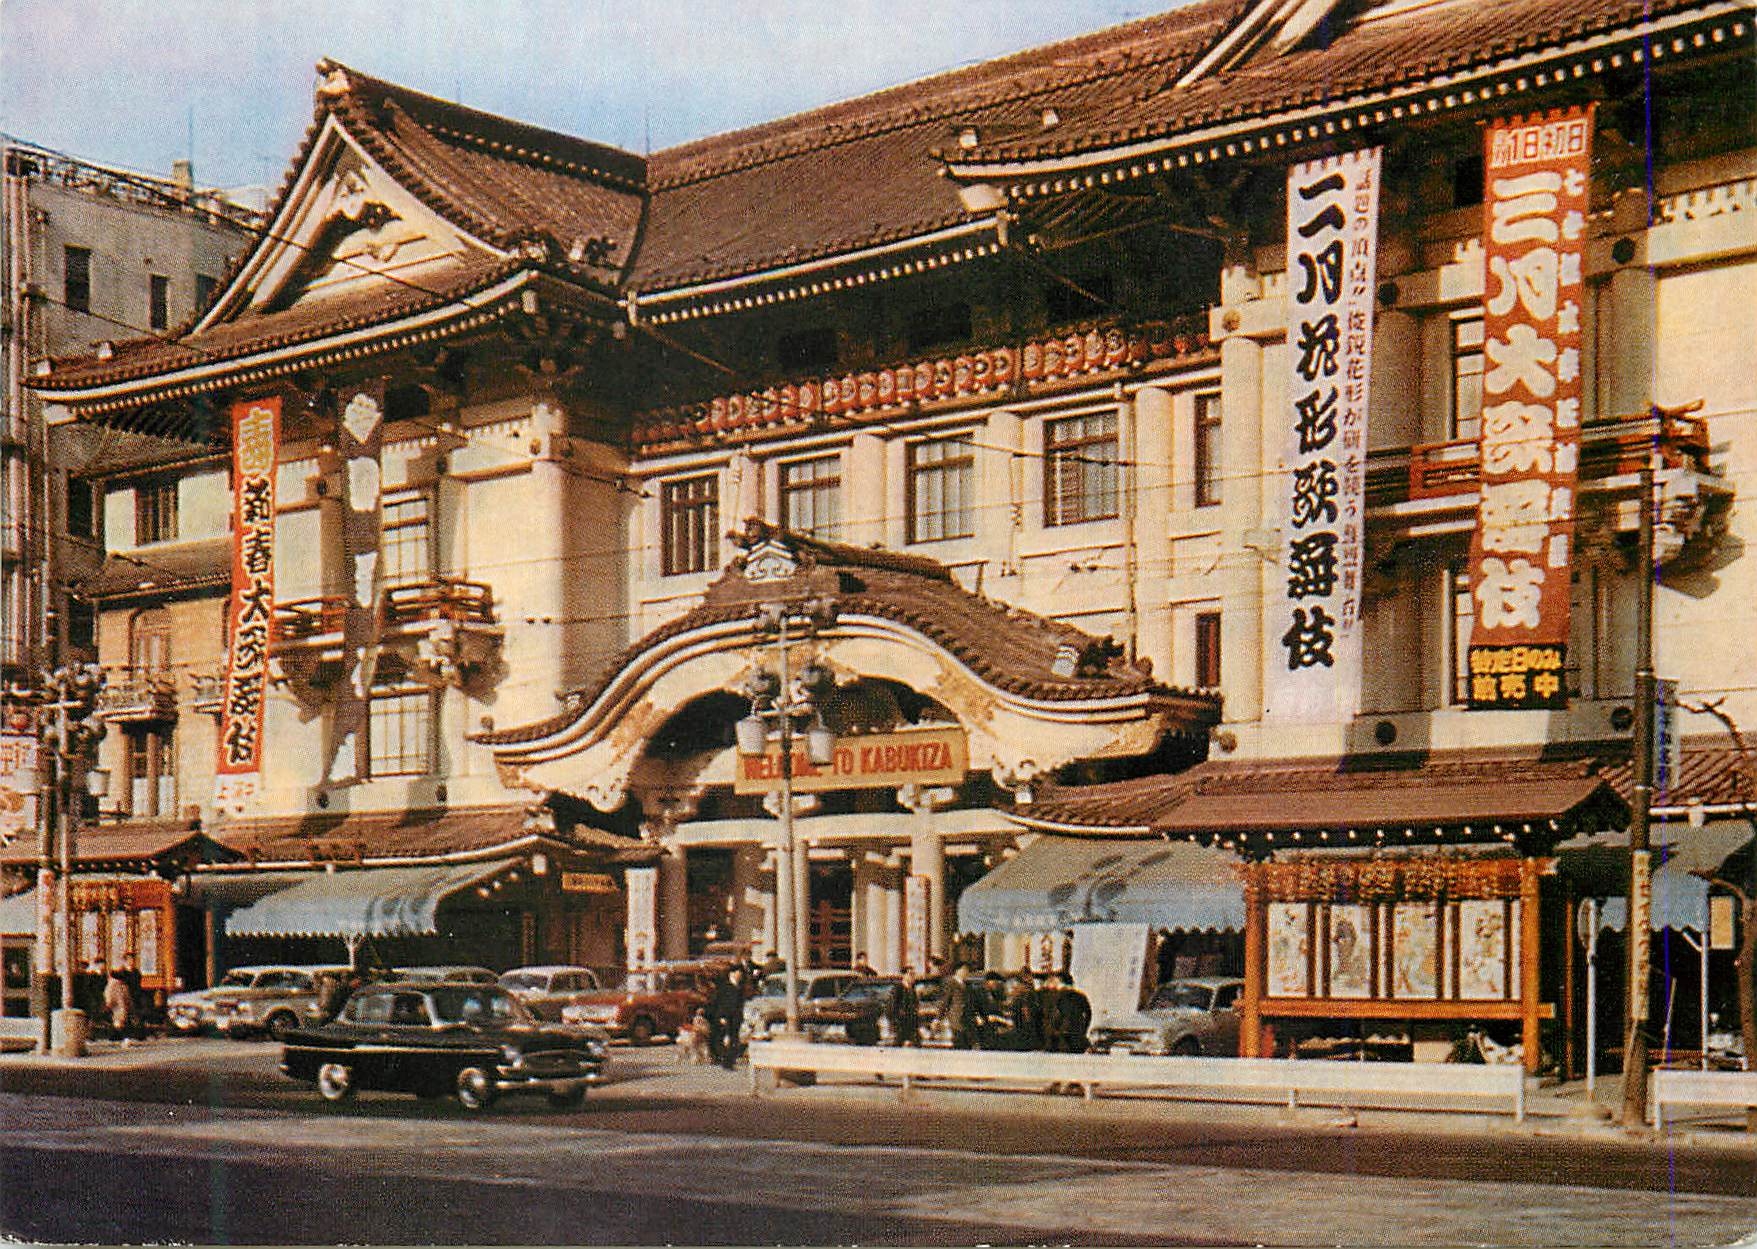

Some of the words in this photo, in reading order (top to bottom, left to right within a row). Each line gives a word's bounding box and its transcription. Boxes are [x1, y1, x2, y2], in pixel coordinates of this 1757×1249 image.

[1282, 171, 1346, 671] 二月花形歌舞伎
[832, 748, 855, 775] TO
[861, 742, 952, 774] KABUKIZA
